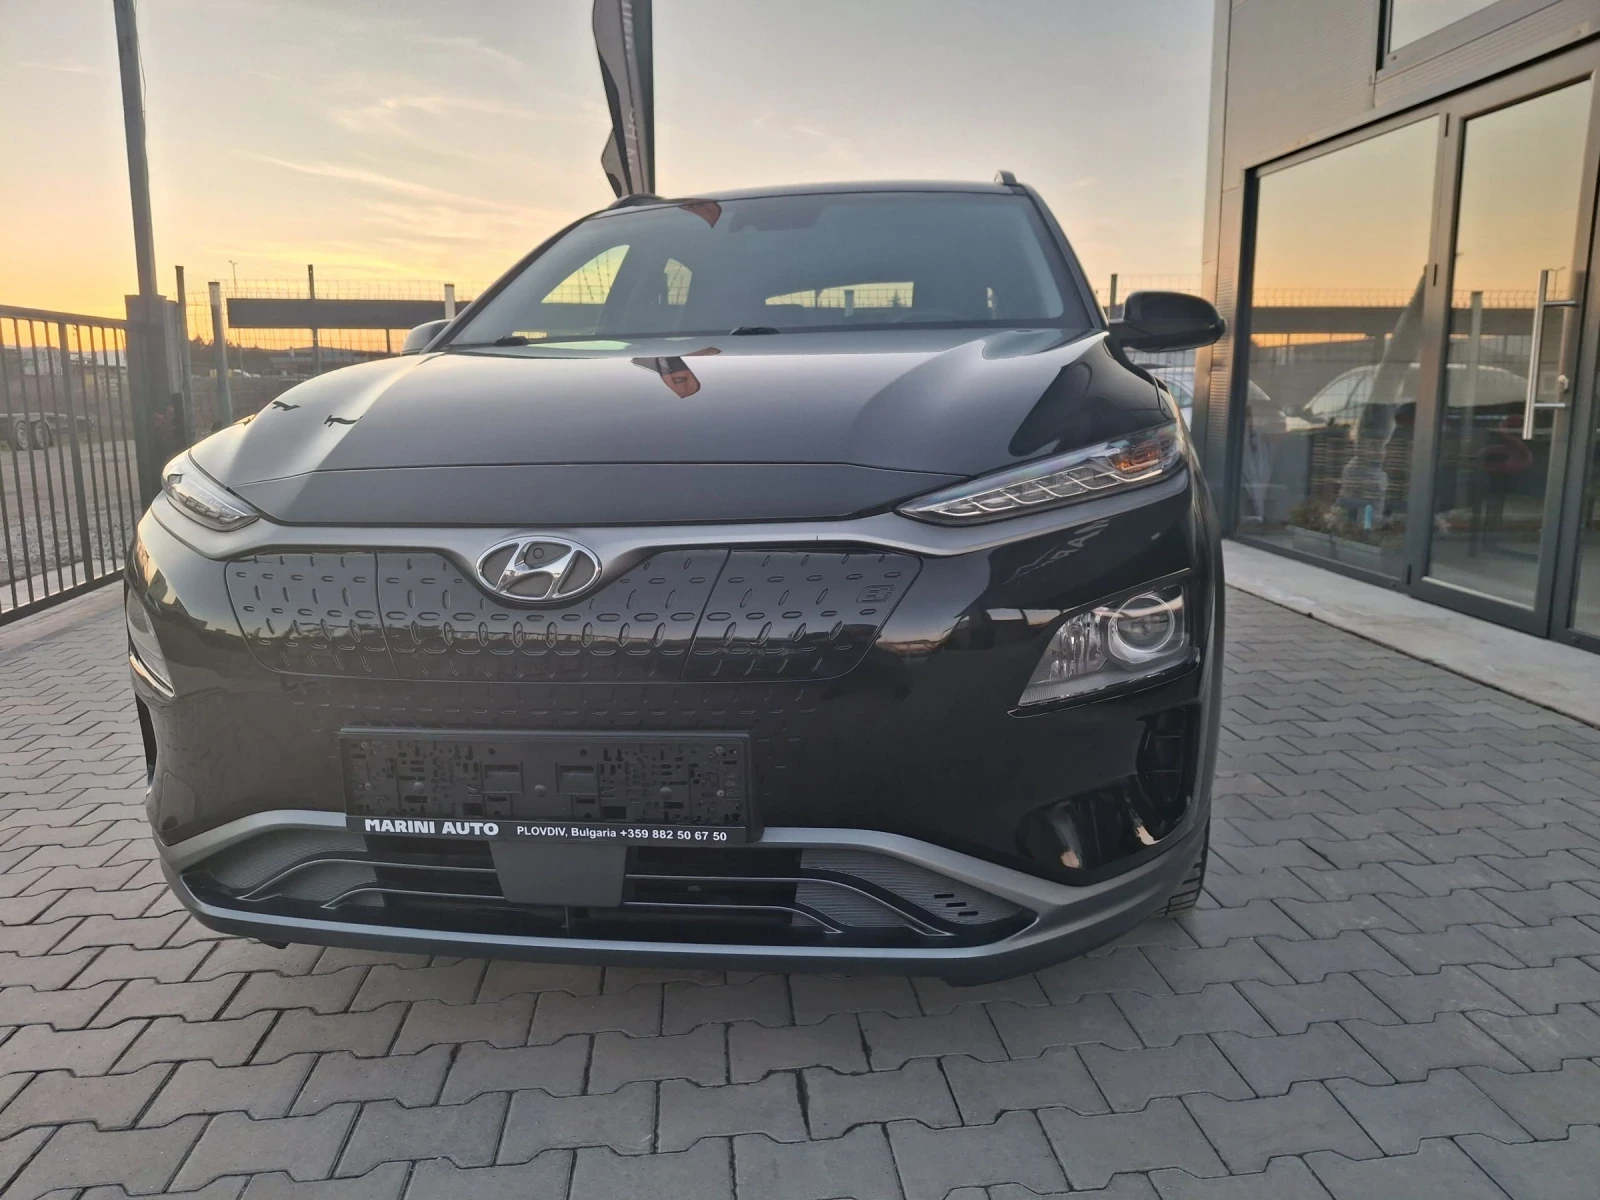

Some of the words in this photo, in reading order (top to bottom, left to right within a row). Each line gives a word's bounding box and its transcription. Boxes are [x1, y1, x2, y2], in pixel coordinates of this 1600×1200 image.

[364, 818, 436, 834] MARINI
[441, 821, 500, 836] AUTO
[516, 825, 568, 838] PLOVDIV,
[571, 827, 617, 839] Bulgaria
[619, 828, 649, 839] +359
[652, 829, 674, 840] 882
[677, 830, 692, 841] 50
[694, 831, 709, 841] 67
[712, 831, 727, 842] 50
